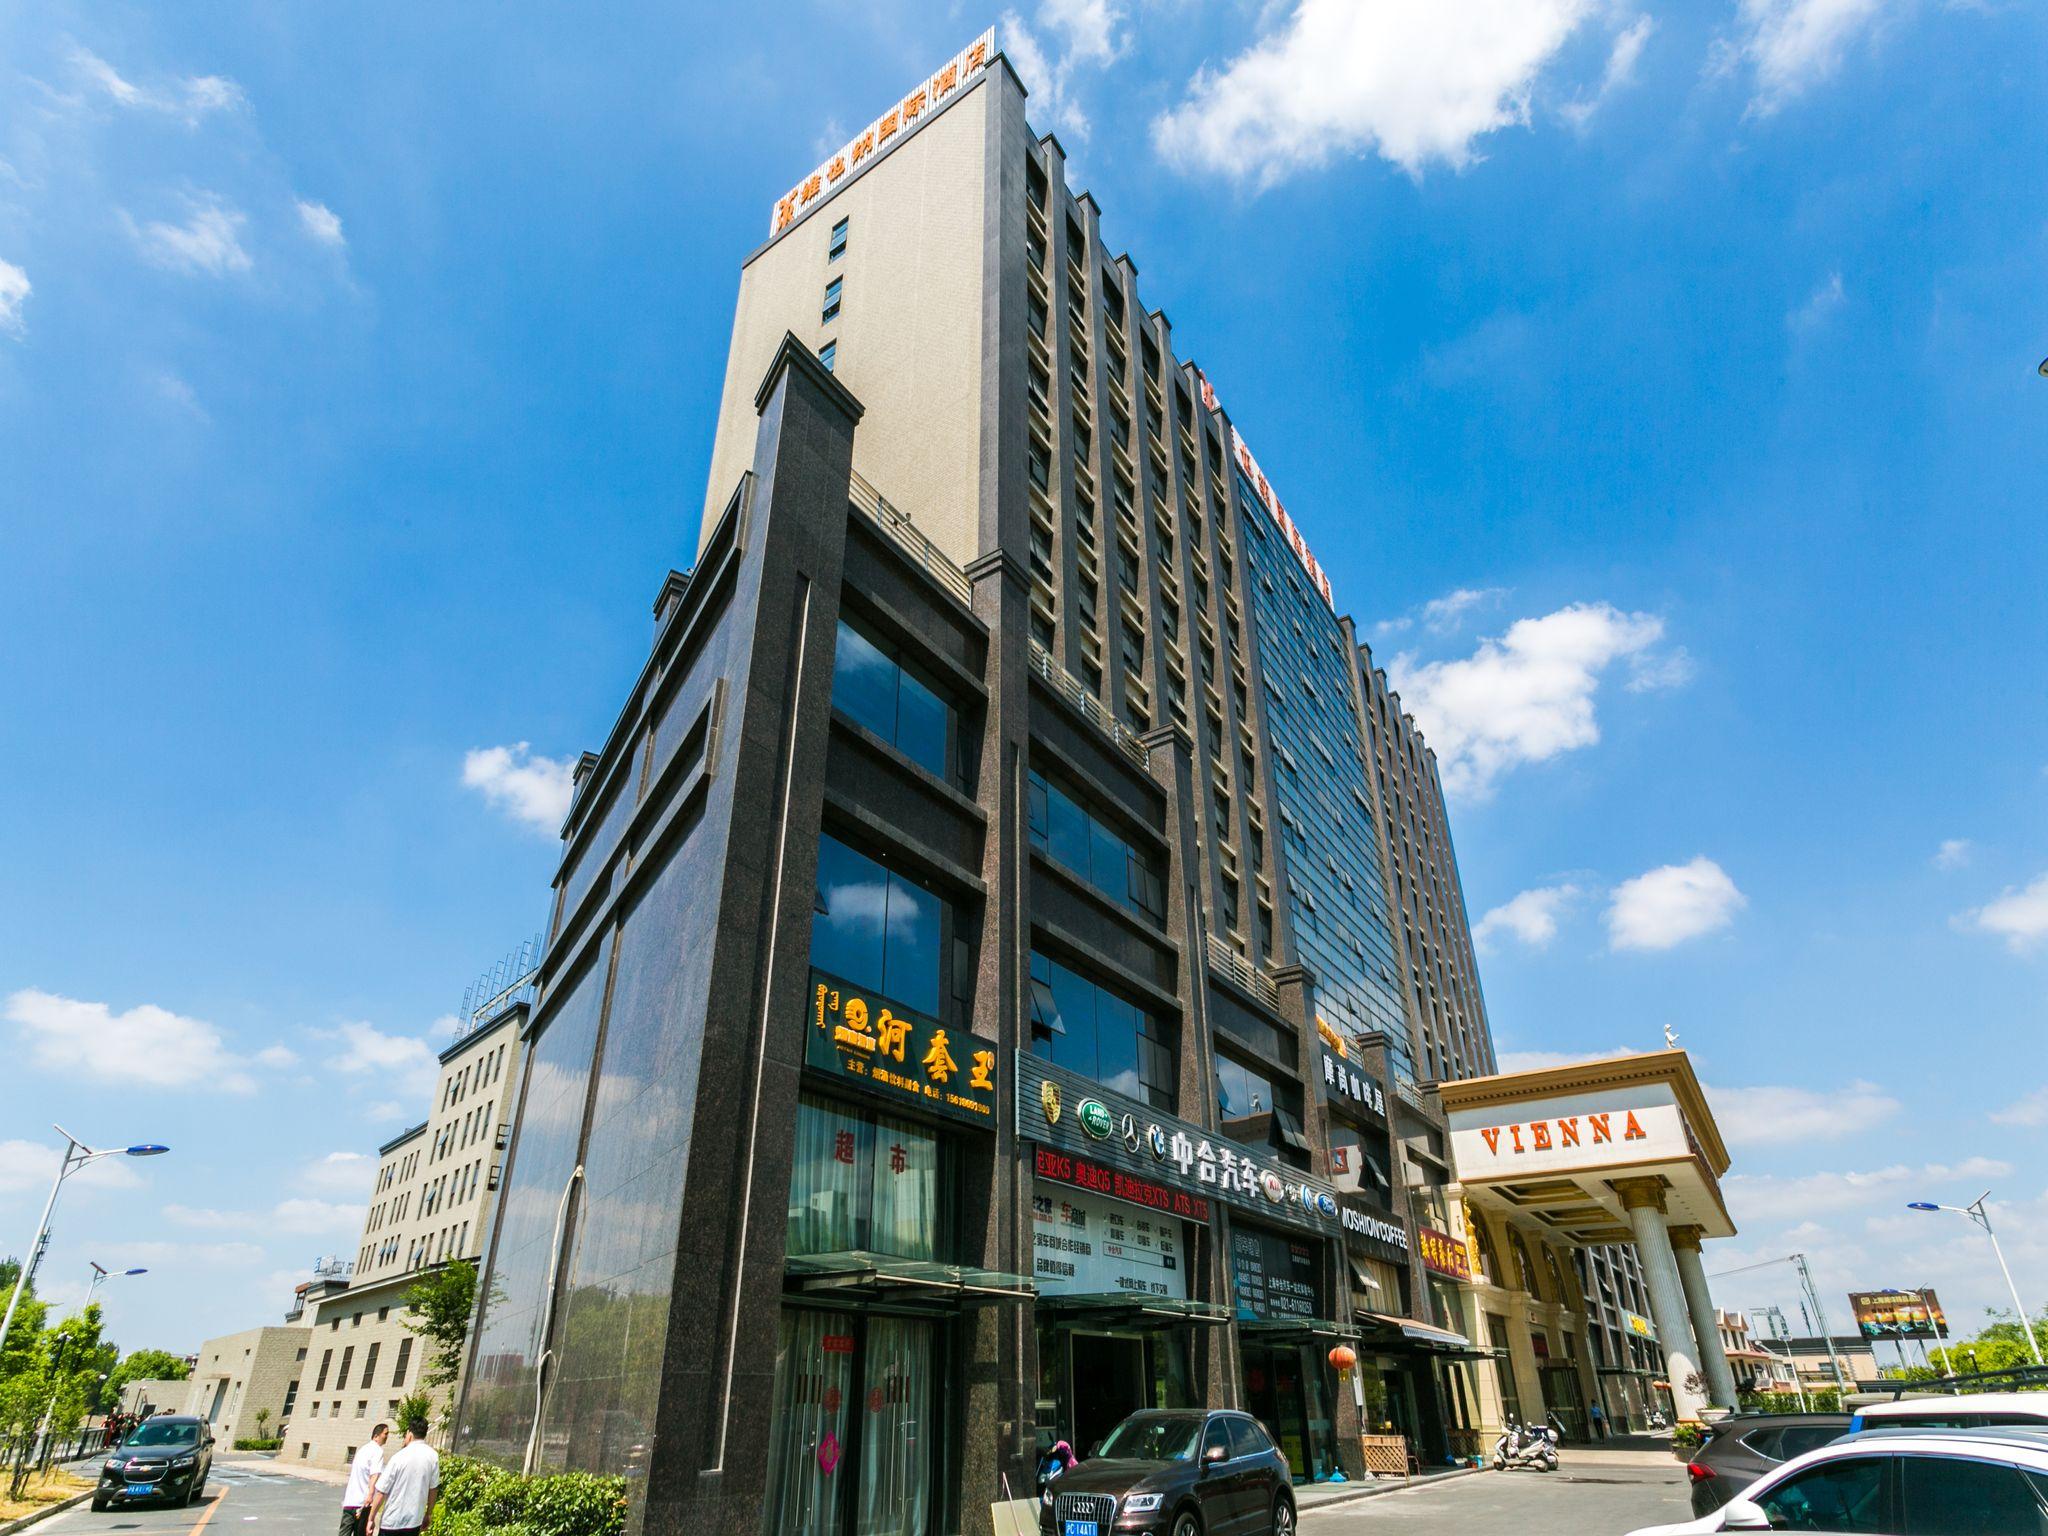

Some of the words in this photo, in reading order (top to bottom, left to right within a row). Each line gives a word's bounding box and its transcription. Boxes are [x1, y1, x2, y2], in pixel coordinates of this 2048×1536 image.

[800, 42, 986, 205] 维也纳国际酒店
[877, 1008, 994, 1091] 河套王
[1091, 1116, 1110, 1130] ROVER
[1482, 1110, 1647, 1155] VIENNA
[834, 1130, 907, 1175] 超市
[1171, 1131, 1260, 1197] 中合汽车
[1075, 1162, 1111, 1191] 奥迪Q5
[1174, 1194, 1191, 1214] ATS
[1378, 1221, 1408, 1249] COFFEE
